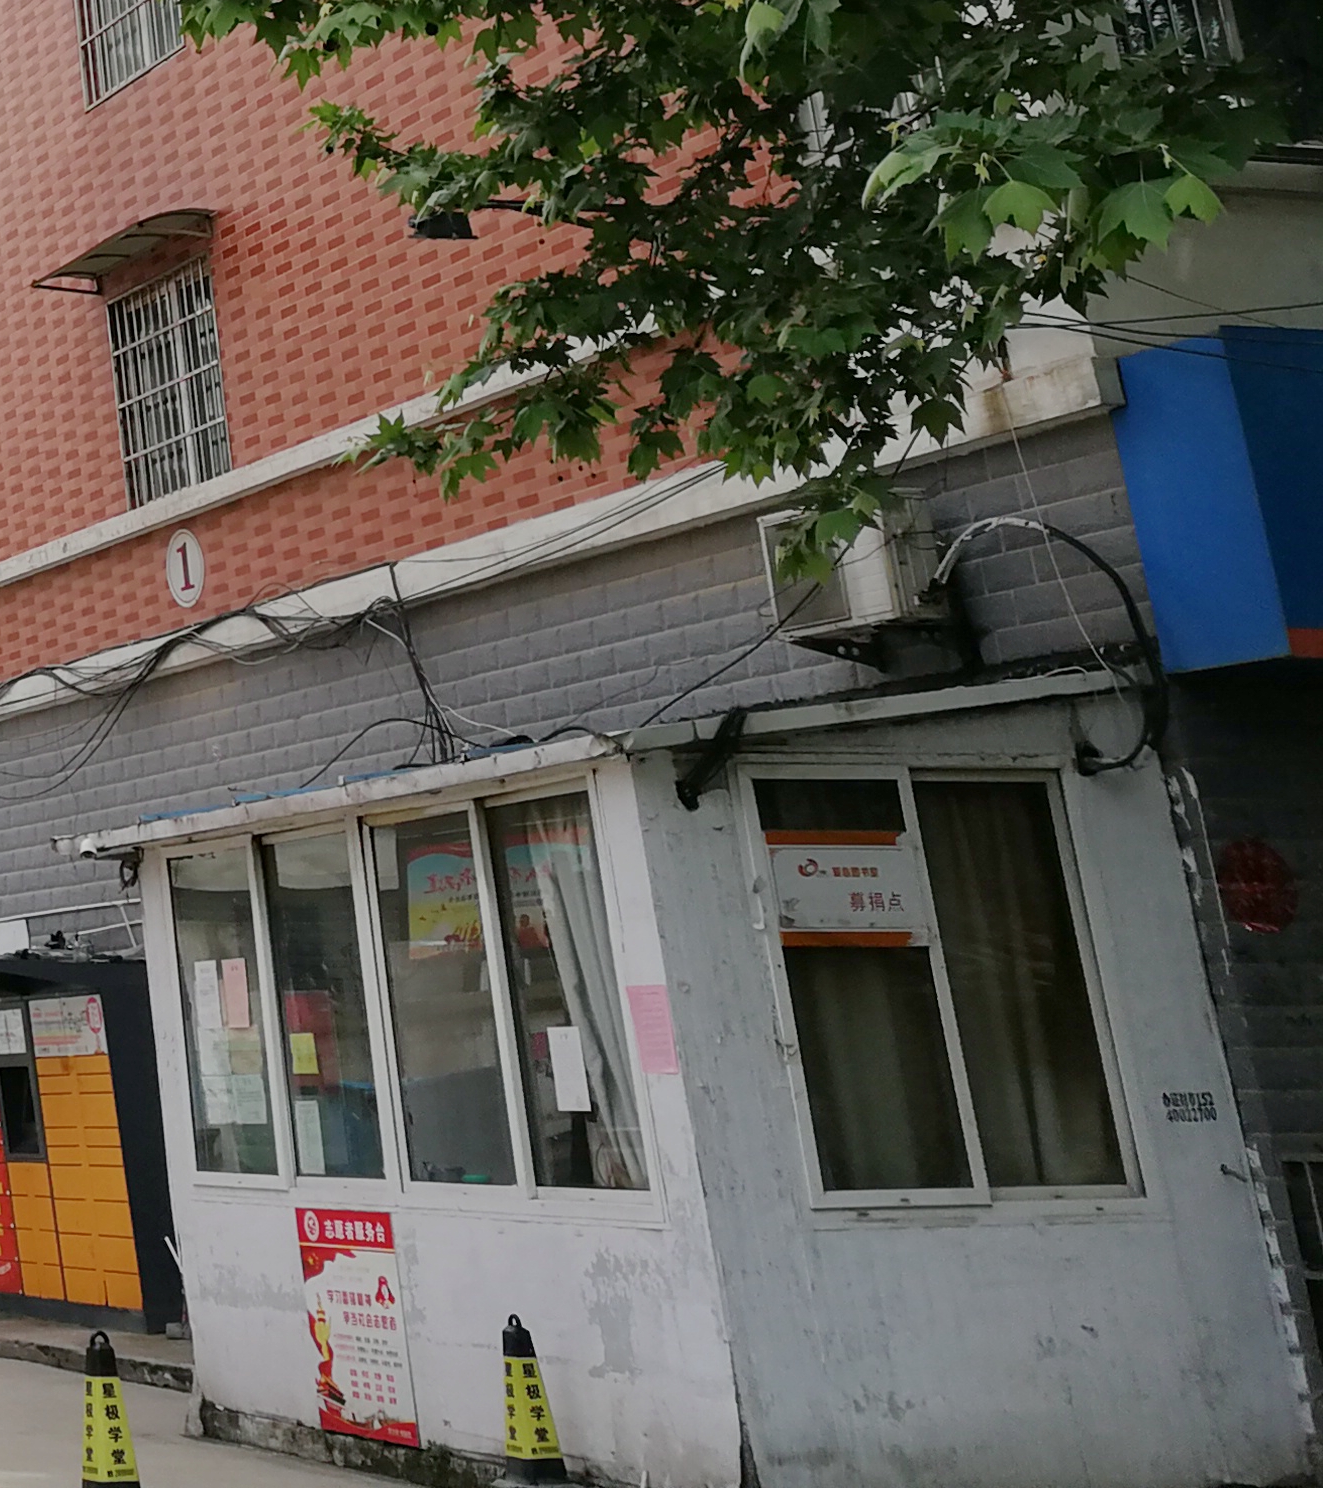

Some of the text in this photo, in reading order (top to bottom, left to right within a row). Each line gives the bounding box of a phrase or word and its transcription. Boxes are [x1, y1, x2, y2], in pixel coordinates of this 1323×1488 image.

[176, 541, 195, 592] 1
[849, 891, 904, 912] 募捐点
[323, 1219, 385, 1243] 志愿者服务台
